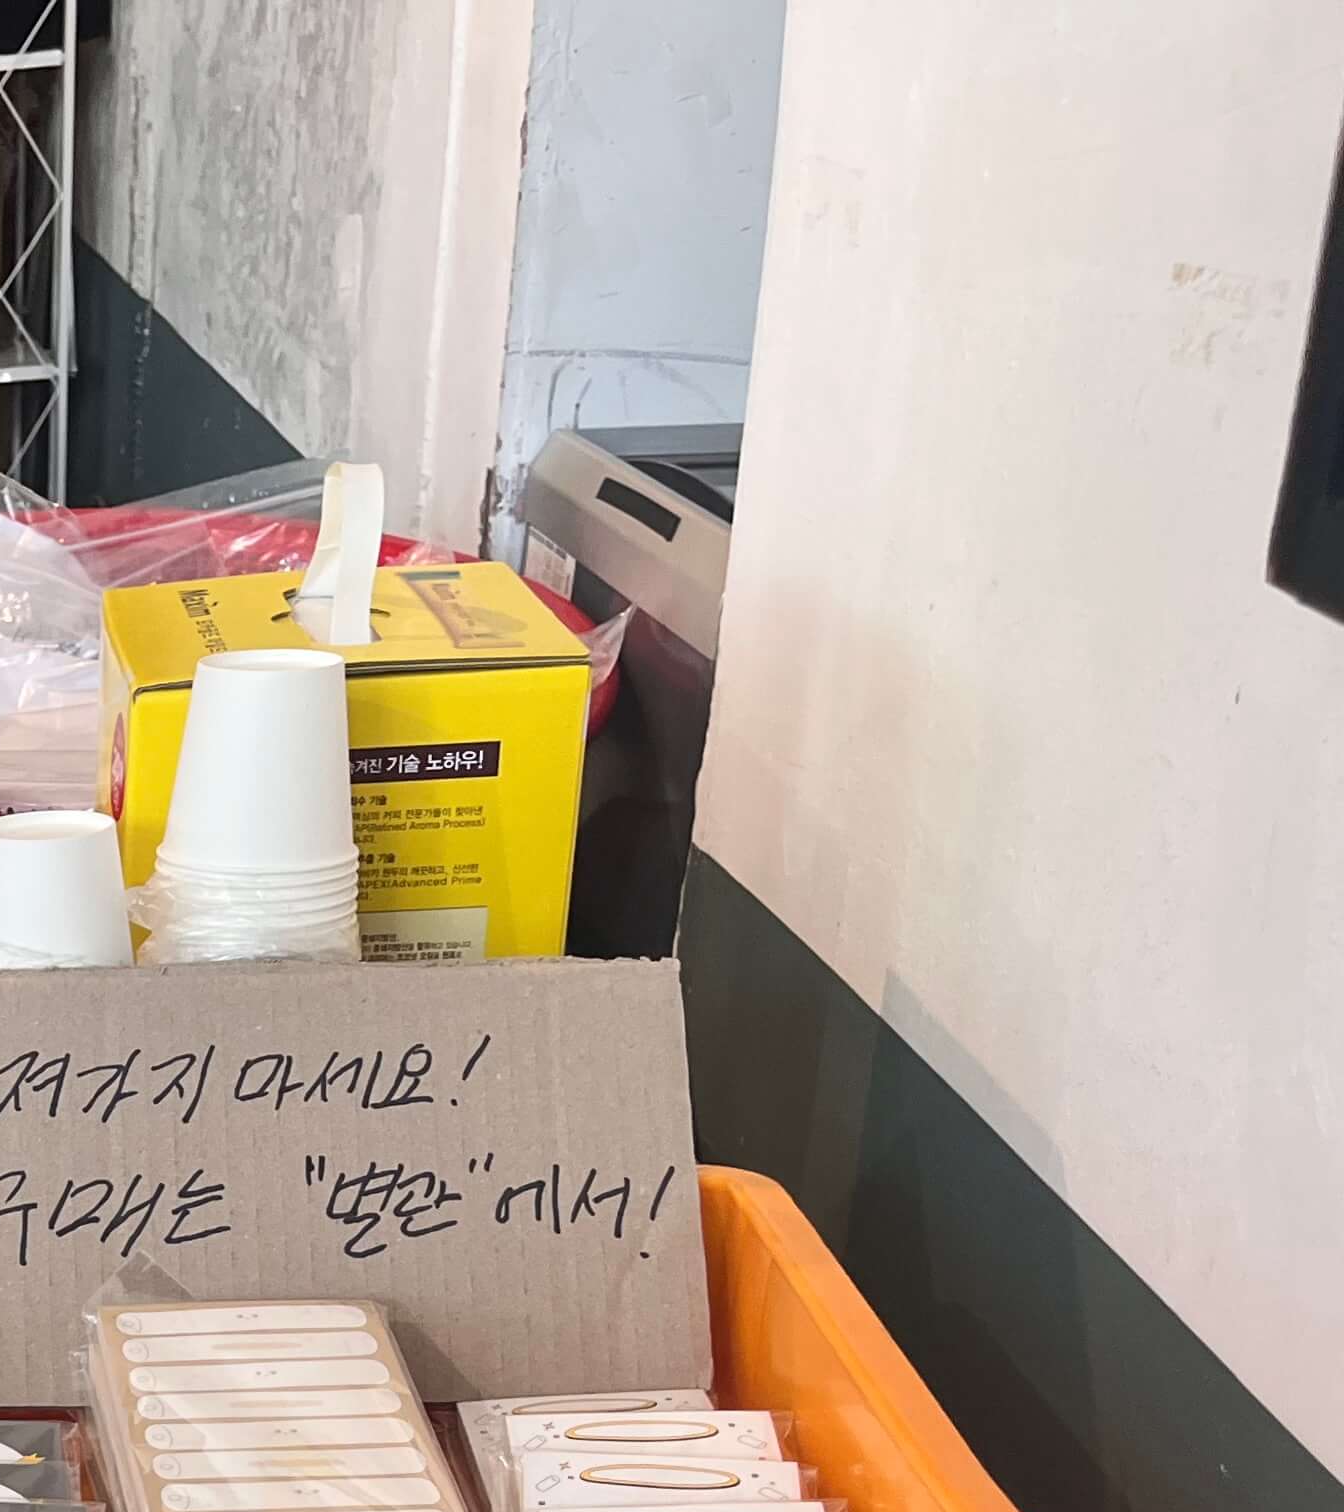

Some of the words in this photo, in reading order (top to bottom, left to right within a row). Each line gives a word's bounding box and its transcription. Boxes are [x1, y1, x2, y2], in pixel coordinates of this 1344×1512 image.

[386, 754, 421, 774] 기술
[425, 749, 485, 772] 노하우!
[232, 1033, 493, 1112] 마세요!
